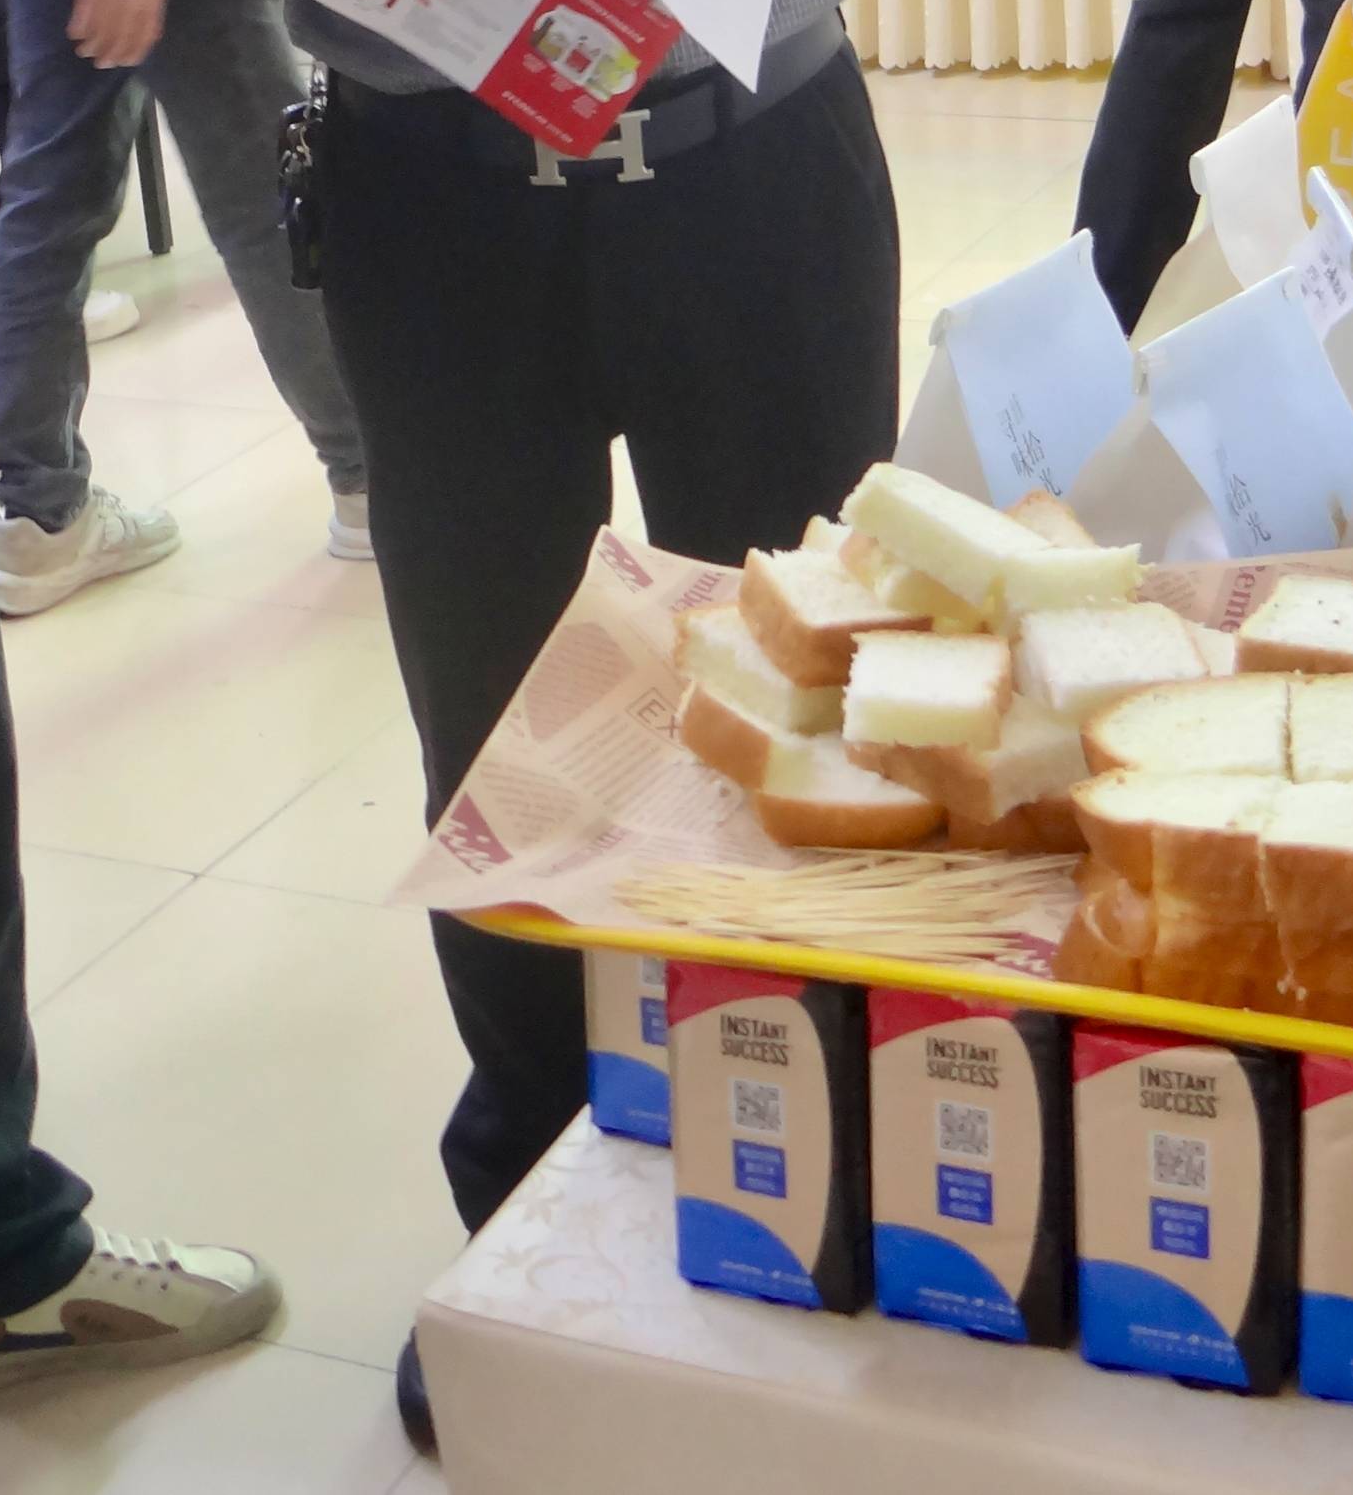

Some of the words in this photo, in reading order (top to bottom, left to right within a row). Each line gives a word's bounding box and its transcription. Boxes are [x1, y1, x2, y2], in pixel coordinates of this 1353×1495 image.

[720, 1013, 789, 1041] INSTANT
[720, 1037, 790, 1066] SUCCESS
[925, 1036, 998, 1065] INSTANT
[925, 1061, 1000, 1089] SUCCESS
[1138, 1064, 1217, 1094] INSTANT
[1139, 1089, 1218, 1119] SUCCESS
